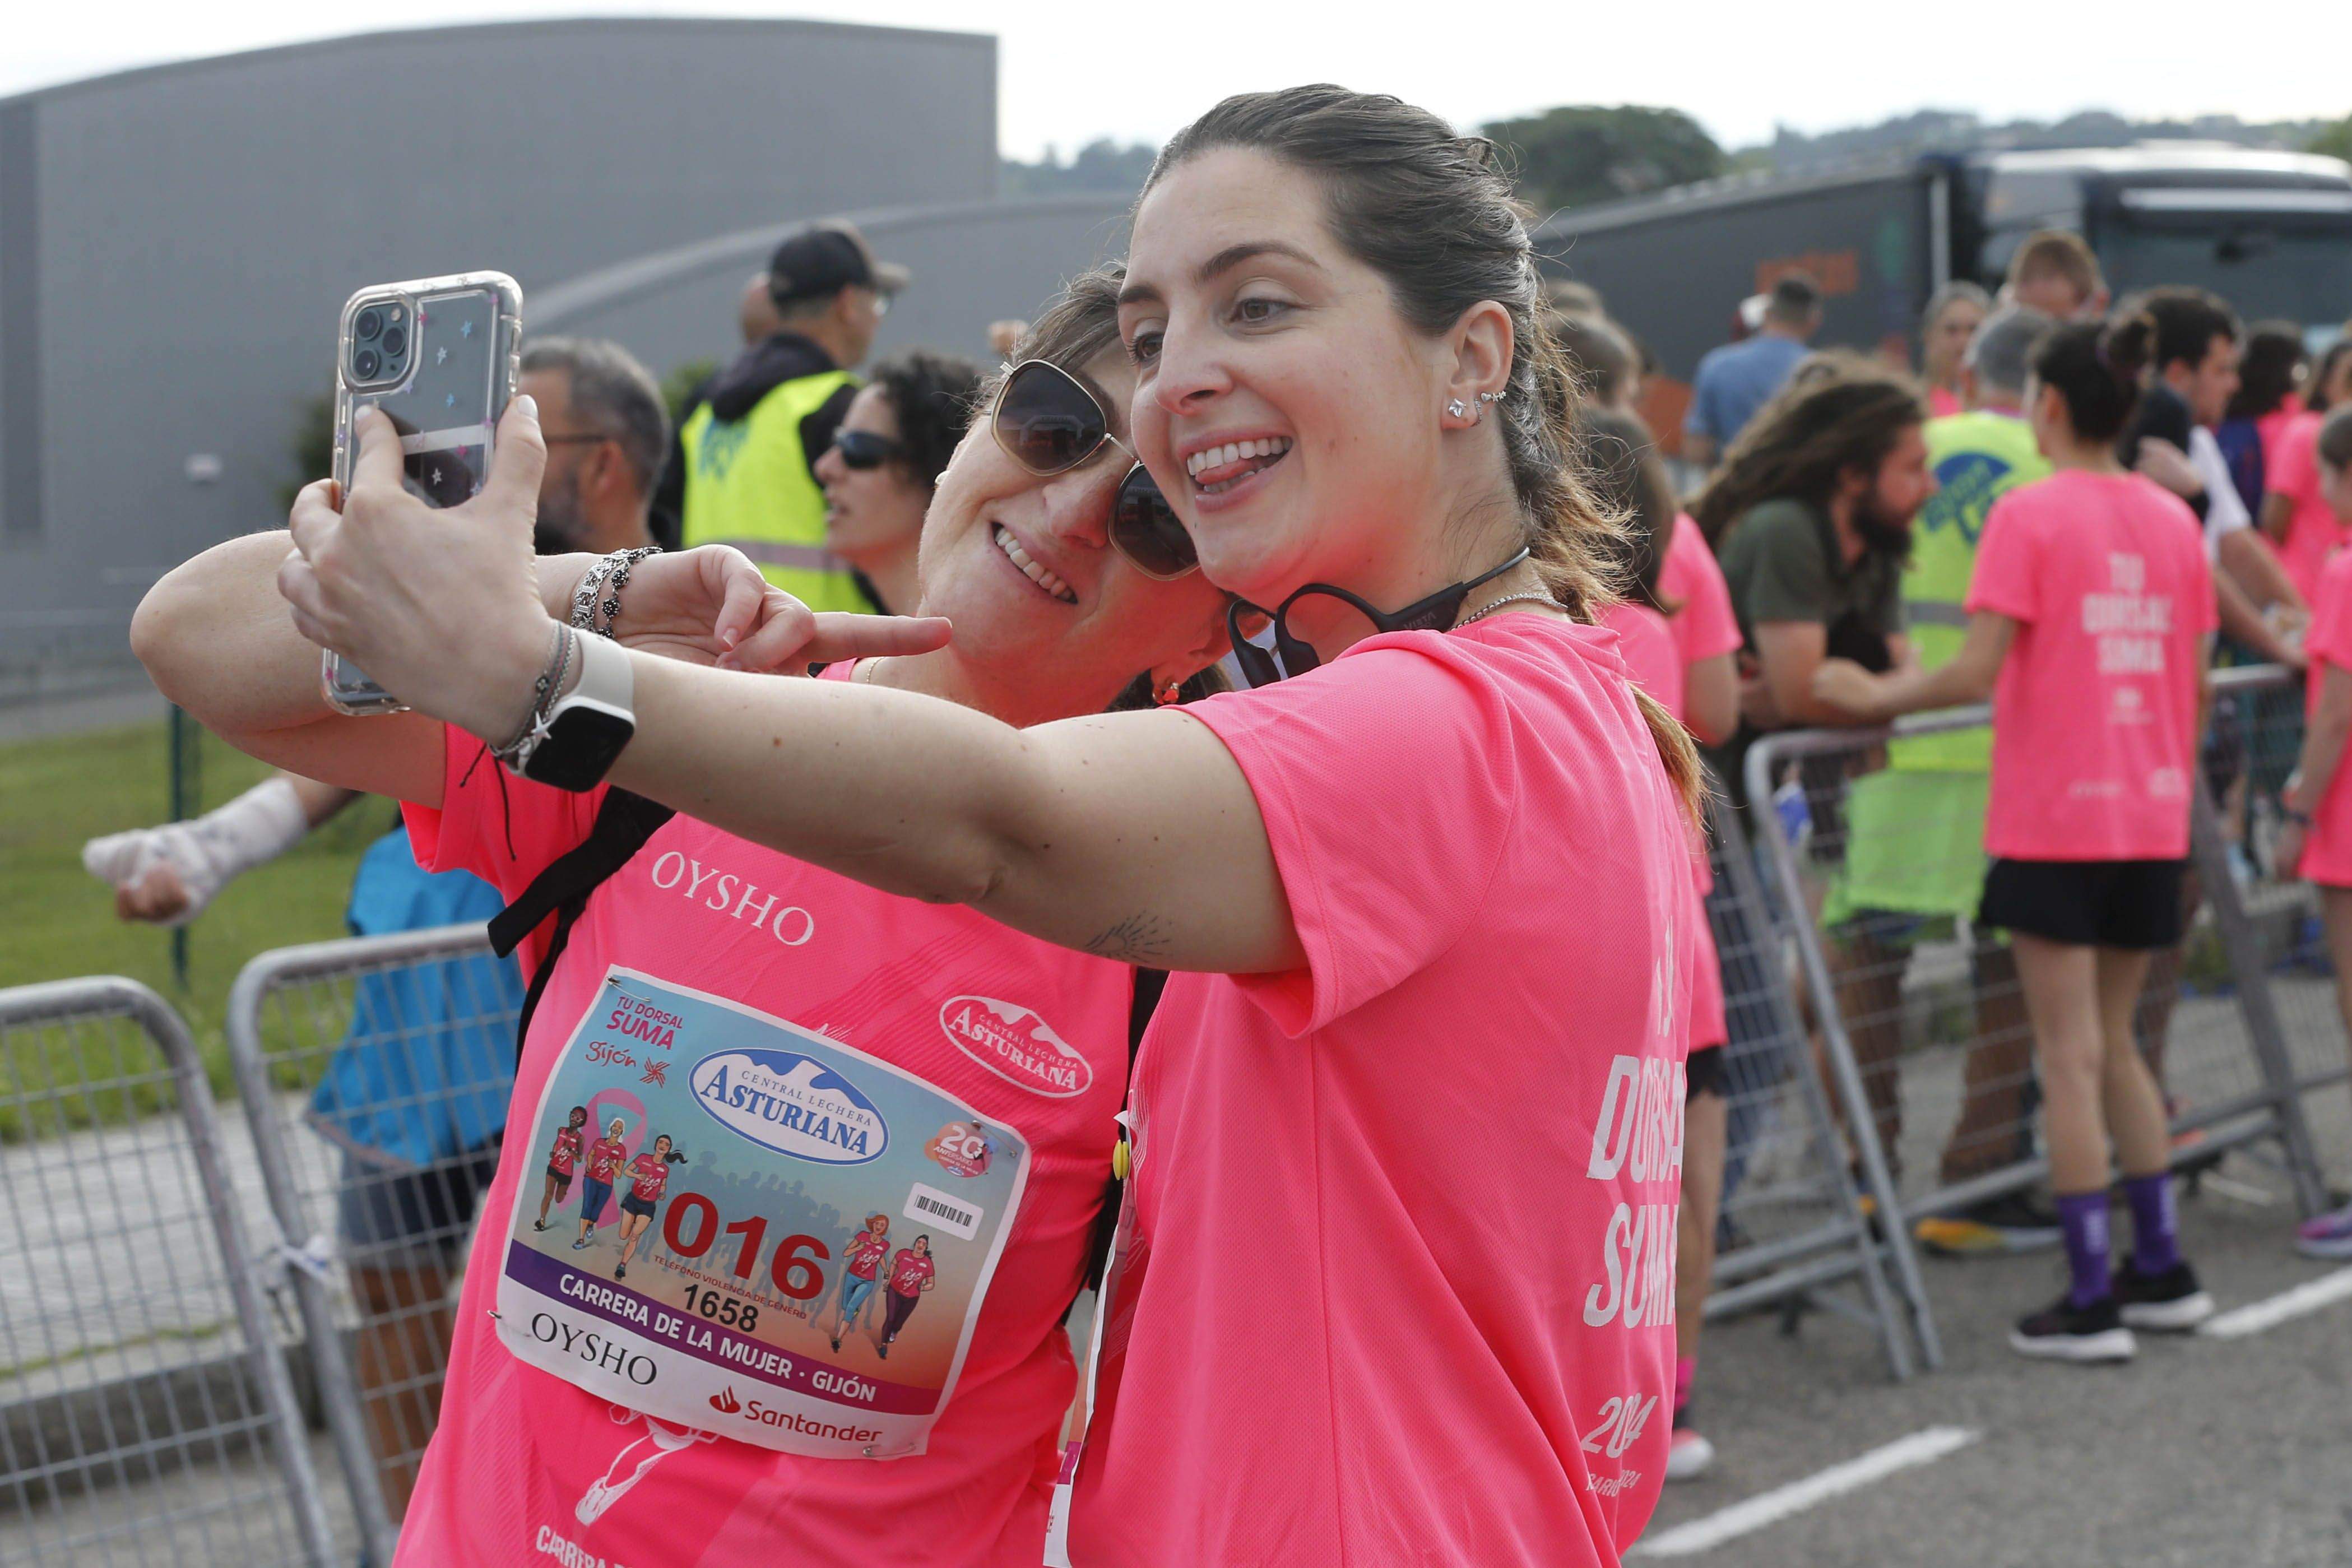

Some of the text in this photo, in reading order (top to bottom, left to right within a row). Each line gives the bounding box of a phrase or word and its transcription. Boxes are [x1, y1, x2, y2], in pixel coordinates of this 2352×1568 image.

[652, 851, 814, 946] OYSHO
[606, 1010, 675, 1050] SUMA
[617, 996, 683, 1029] TU DORSAL
[948, 1006, 1077, 1090] ASTURIANA
[978, 1014, 1078, 1069] CENTRAL LECHERA
[700, 1064, 869, 1156] ASTURIANA
[741, 1070, 871, 1126] CENTRAL LECHERA
[663, 1192, 830, 1301] 016
[684, 1283, 759, 1333] 1658
[702, 1275, 753, 1300] VIOLENCIA
[753, 1294, 766, 1305] DE
[531, 1312, 657, 1385] OYSHO
[559, 1273, 876, 1402] CARRERA DE LA MUJER GIJÓN
[744, 1400, 883, 1442] Santander
